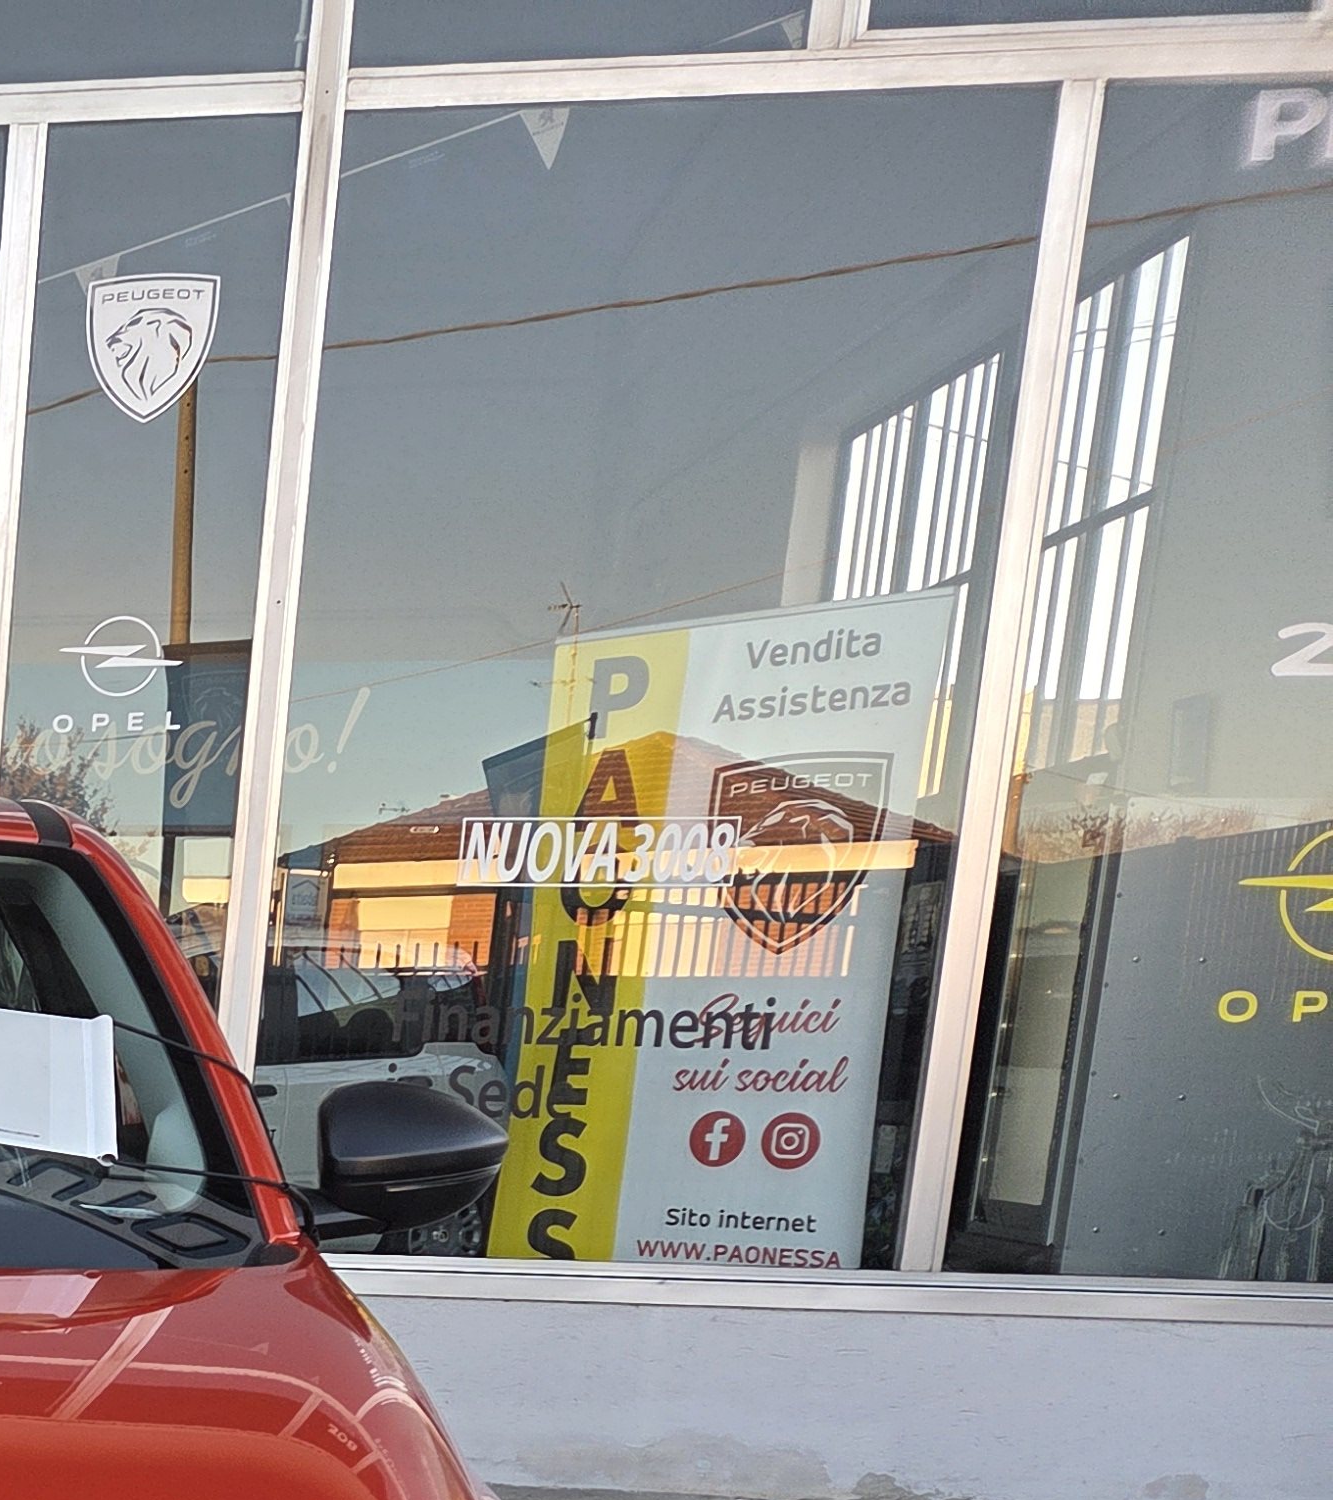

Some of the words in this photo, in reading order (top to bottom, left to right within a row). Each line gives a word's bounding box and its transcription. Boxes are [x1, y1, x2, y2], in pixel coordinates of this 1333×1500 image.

[102, 287, 205, 305] PEUGEOT
[746, 628, 882, 669] Vendita
[713, 679, 912, 724] Assistenza
[52, 711, 181, 734] OPEL
[729, 771, 873, 798] PEUGEOT
[464, 822, 617, 883] NUOVA
[624, 822, 734, 883] 3008
[391, 990, 776, 1052] Finanziamenti
[449, 1064, 579, 1120] Sede
[673, 1058, 730, 1091] sui
[734, 1055, 849, 1093] social
[665, 1207, 711, 1228] Sito
[718, 1209, 818, 1233] internet
[637, 1239, 842, 1269] WWW.PAONESSA
